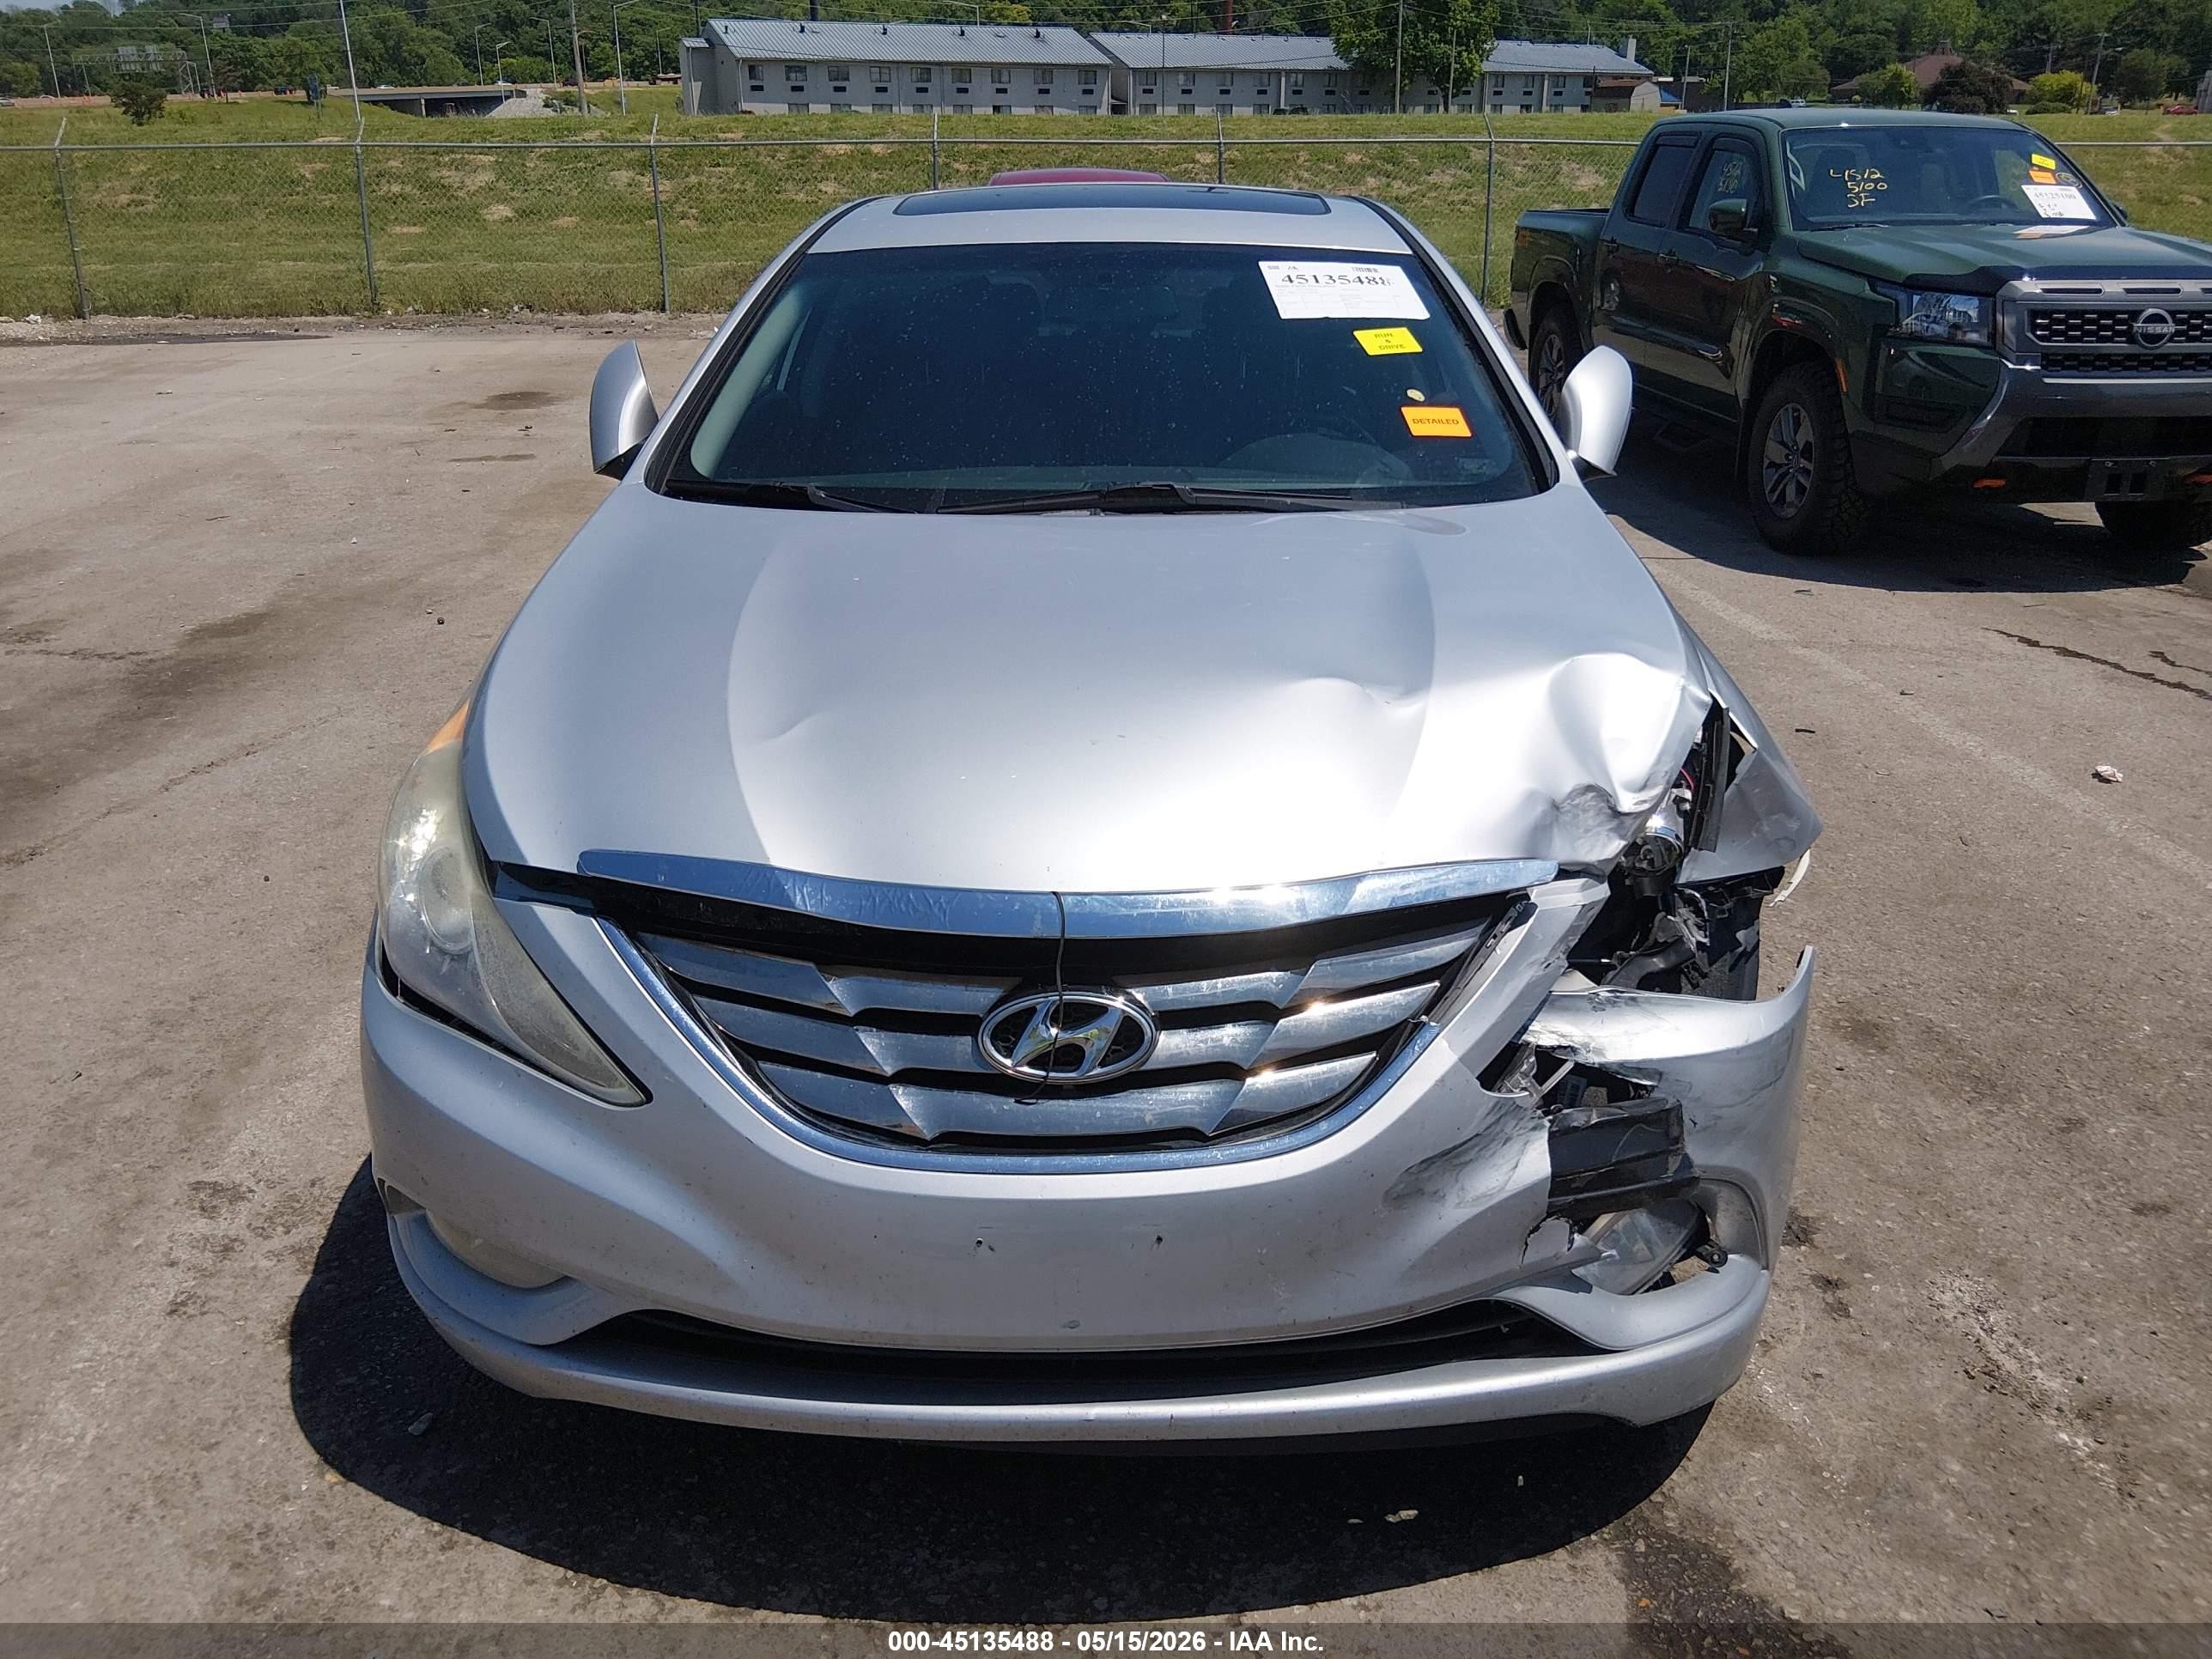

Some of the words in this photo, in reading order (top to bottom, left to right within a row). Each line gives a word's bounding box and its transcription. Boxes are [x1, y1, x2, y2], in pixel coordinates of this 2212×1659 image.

[1847, 181, 1888, 193] 5100
[1846, 193, 1876, 208] SF
[2133, 325, 2175, 334] NISSAN
